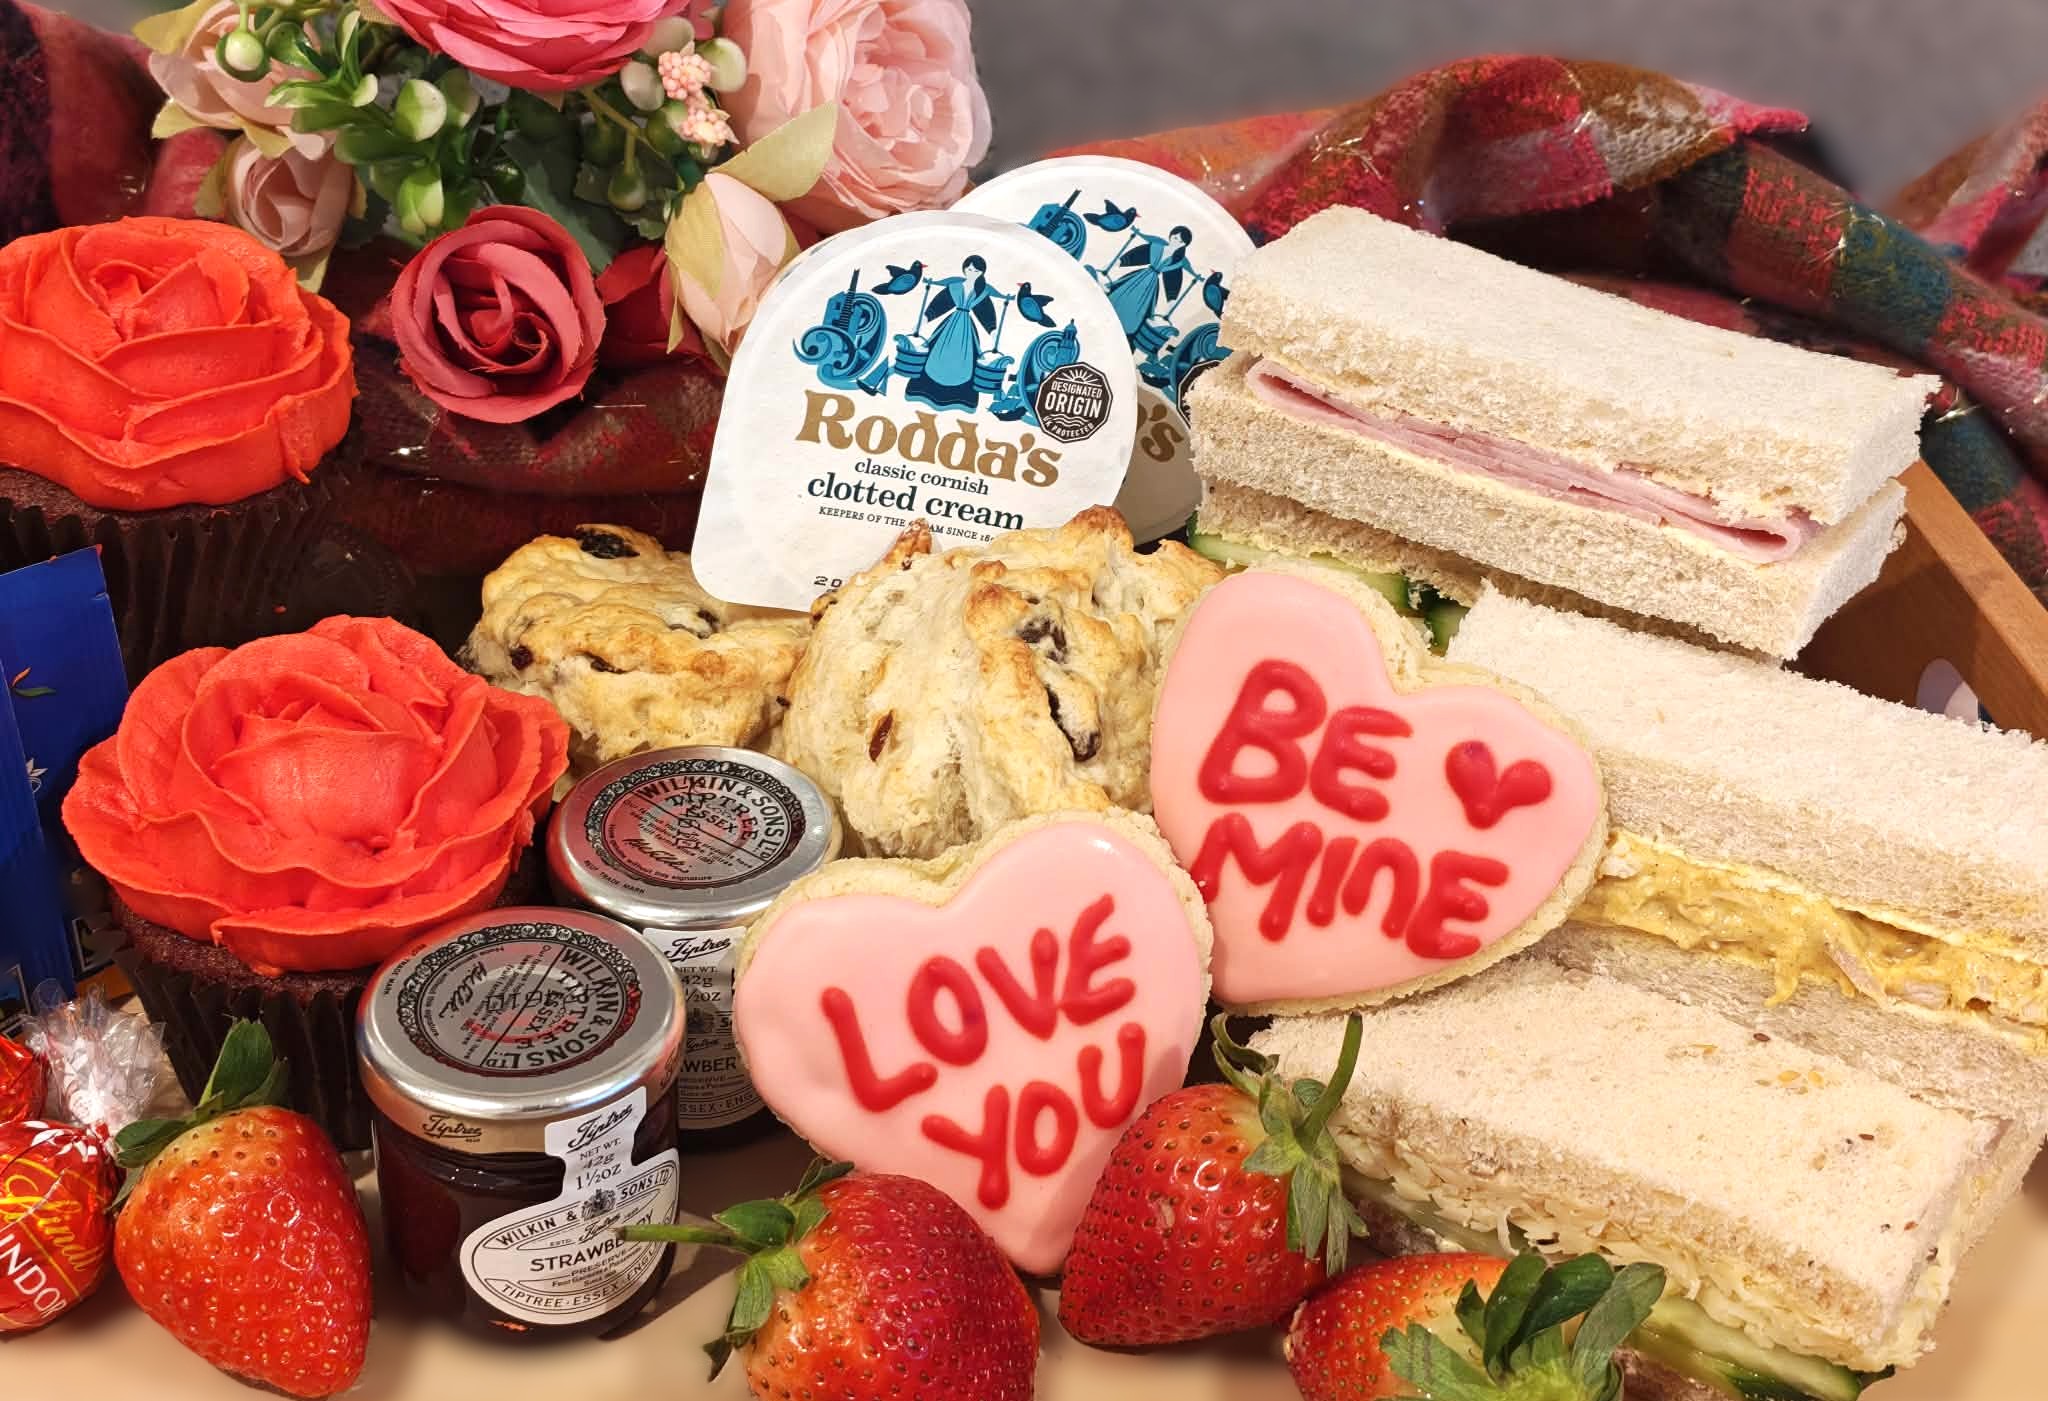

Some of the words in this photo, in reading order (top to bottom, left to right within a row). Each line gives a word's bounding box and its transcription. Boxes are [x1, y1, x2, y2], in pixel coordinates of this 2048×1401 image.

[1045, 391, 1102, 418] ORIGIN
[1051, 381, 1103, 398] DESIGNATED
[795, 390, 1062, 487] Rodda's
[1050, 422, 1095, 437] PROTECTED
[855, 458, 916, 482] classic
[921, 473, 989, 495] cornish
[807, 472, 918, 511] clotted
[925, 497, 1024, 530] cream
[818, 506, 865, 521] KEEPERS
[867, 513, 882, 524] OF
[884, 517, 906, 527] THE
[946, 527, 978, 540] SINCE
[1200, 660, 1413, 822] BE
[637, 776, 738, 799] WILKIN
[737, 785, 753, 799] &
[751, 796, 785, 838] SONS
[666, 791, 759, 841] TIPTREE
[686, 804, 738, 834] ESSEX
[1193, 812, 1509, 960] MINE
[664, 937, 732, 962] Tiptree
[561, 951, 619, 1013] WILKIN
[675, 966, 697, 974] NET
[681, 976, 713, 988] 42g
[526, 989, 565, 1033] ESSEX
[592, 1014, 611, 1027] &
[822, 894, 1136, 1111] LOVE
[525, 1030, 599, 1067] SONS
[680, 1056, 737, 1073] WBER
[422, 1113, 483, 1139] Tiptree
[680, 1102, 720, 1113] SSEX
[922, 1023, 1146, 1209] YOU
[566, 1103, 633, 1155] Tiptree
[580, 1147, 601, 1160] NET
[496, 1217, 557, 1246] WILKIN
[566, 1211, 578, 1222] &
[621, 1176, 653, 1199] SONS
[654, 1167, 670, 1186] LTD
[530, 1208, 654, 1272] STRAWBEY
[0, 1234, 67, 1319] INDOR
[502, 1284, 565, 1308] TIPTREE
[572, 1283, 619, 1306] ESSEX
